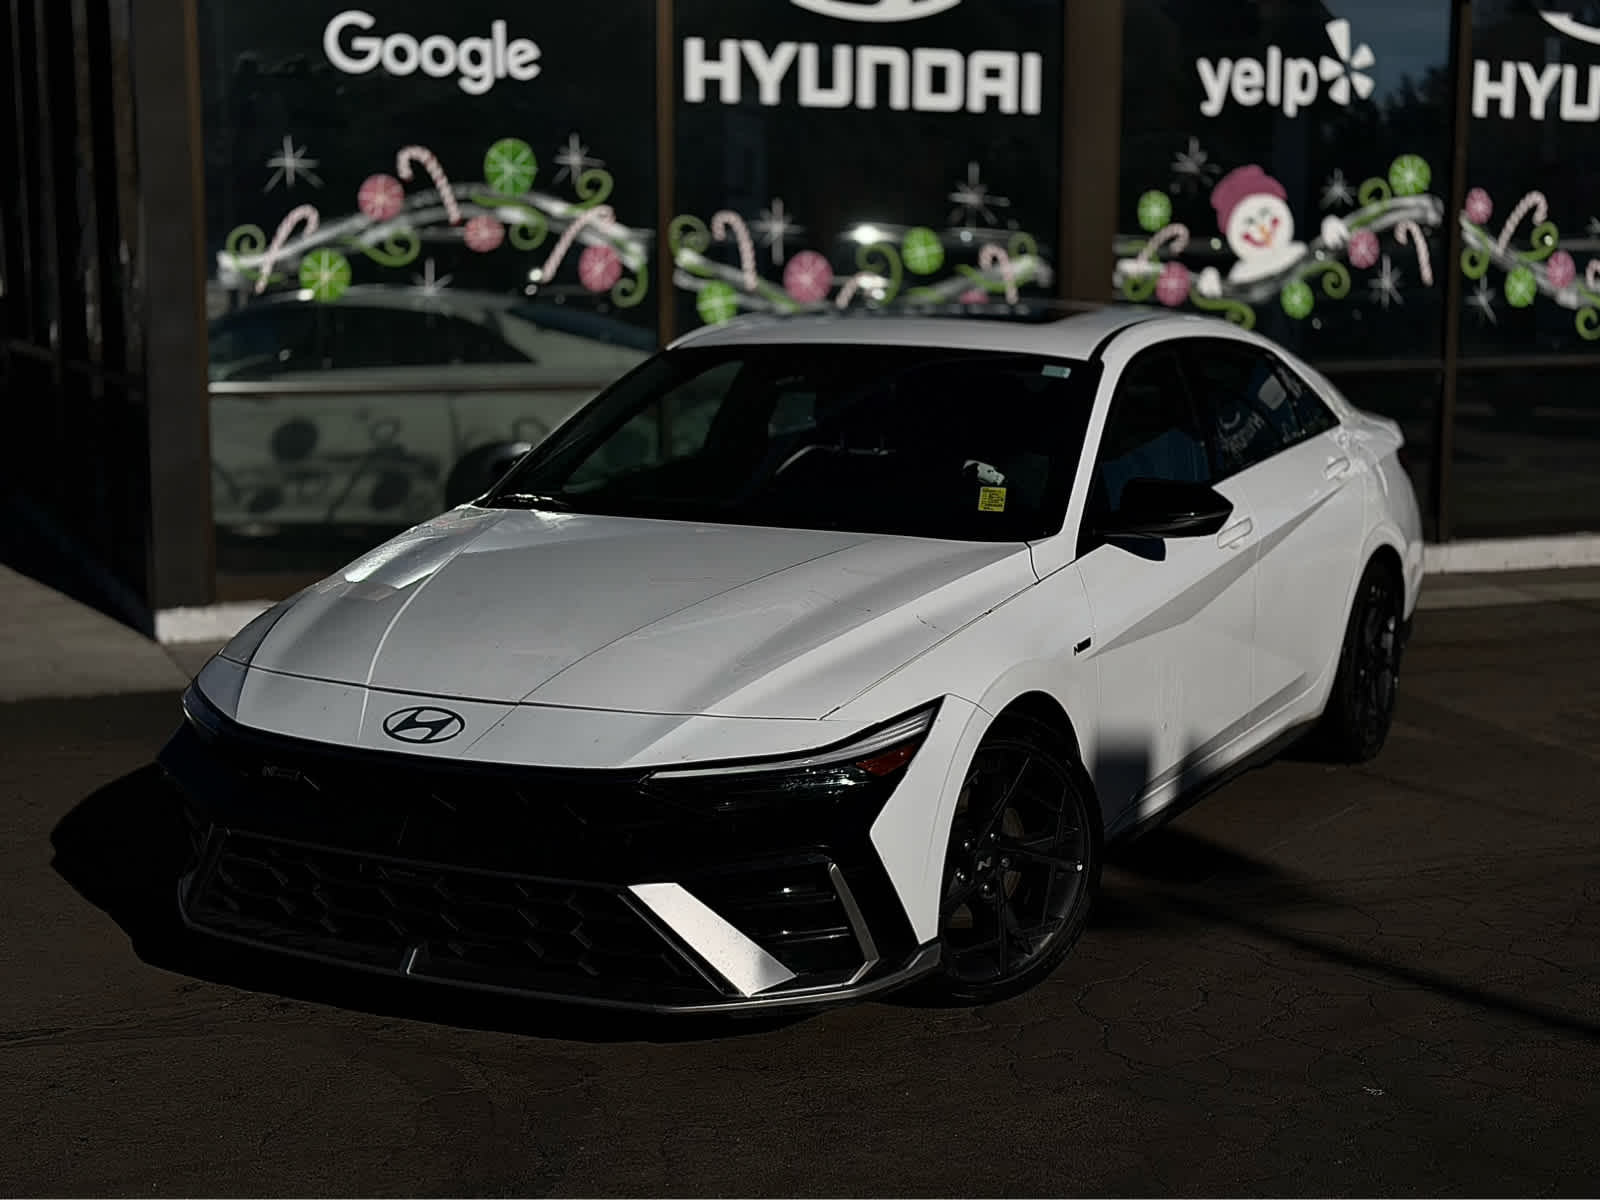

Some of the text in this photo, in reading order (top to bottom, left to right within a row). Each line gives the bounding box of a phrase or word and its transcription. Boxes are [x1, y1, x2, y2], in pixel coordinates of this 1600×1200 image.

[323, 10, 541, 95] Google
[684, 37, 1042, 115] HYUNDAI
[1197, 45, 1319, 118] yelp
